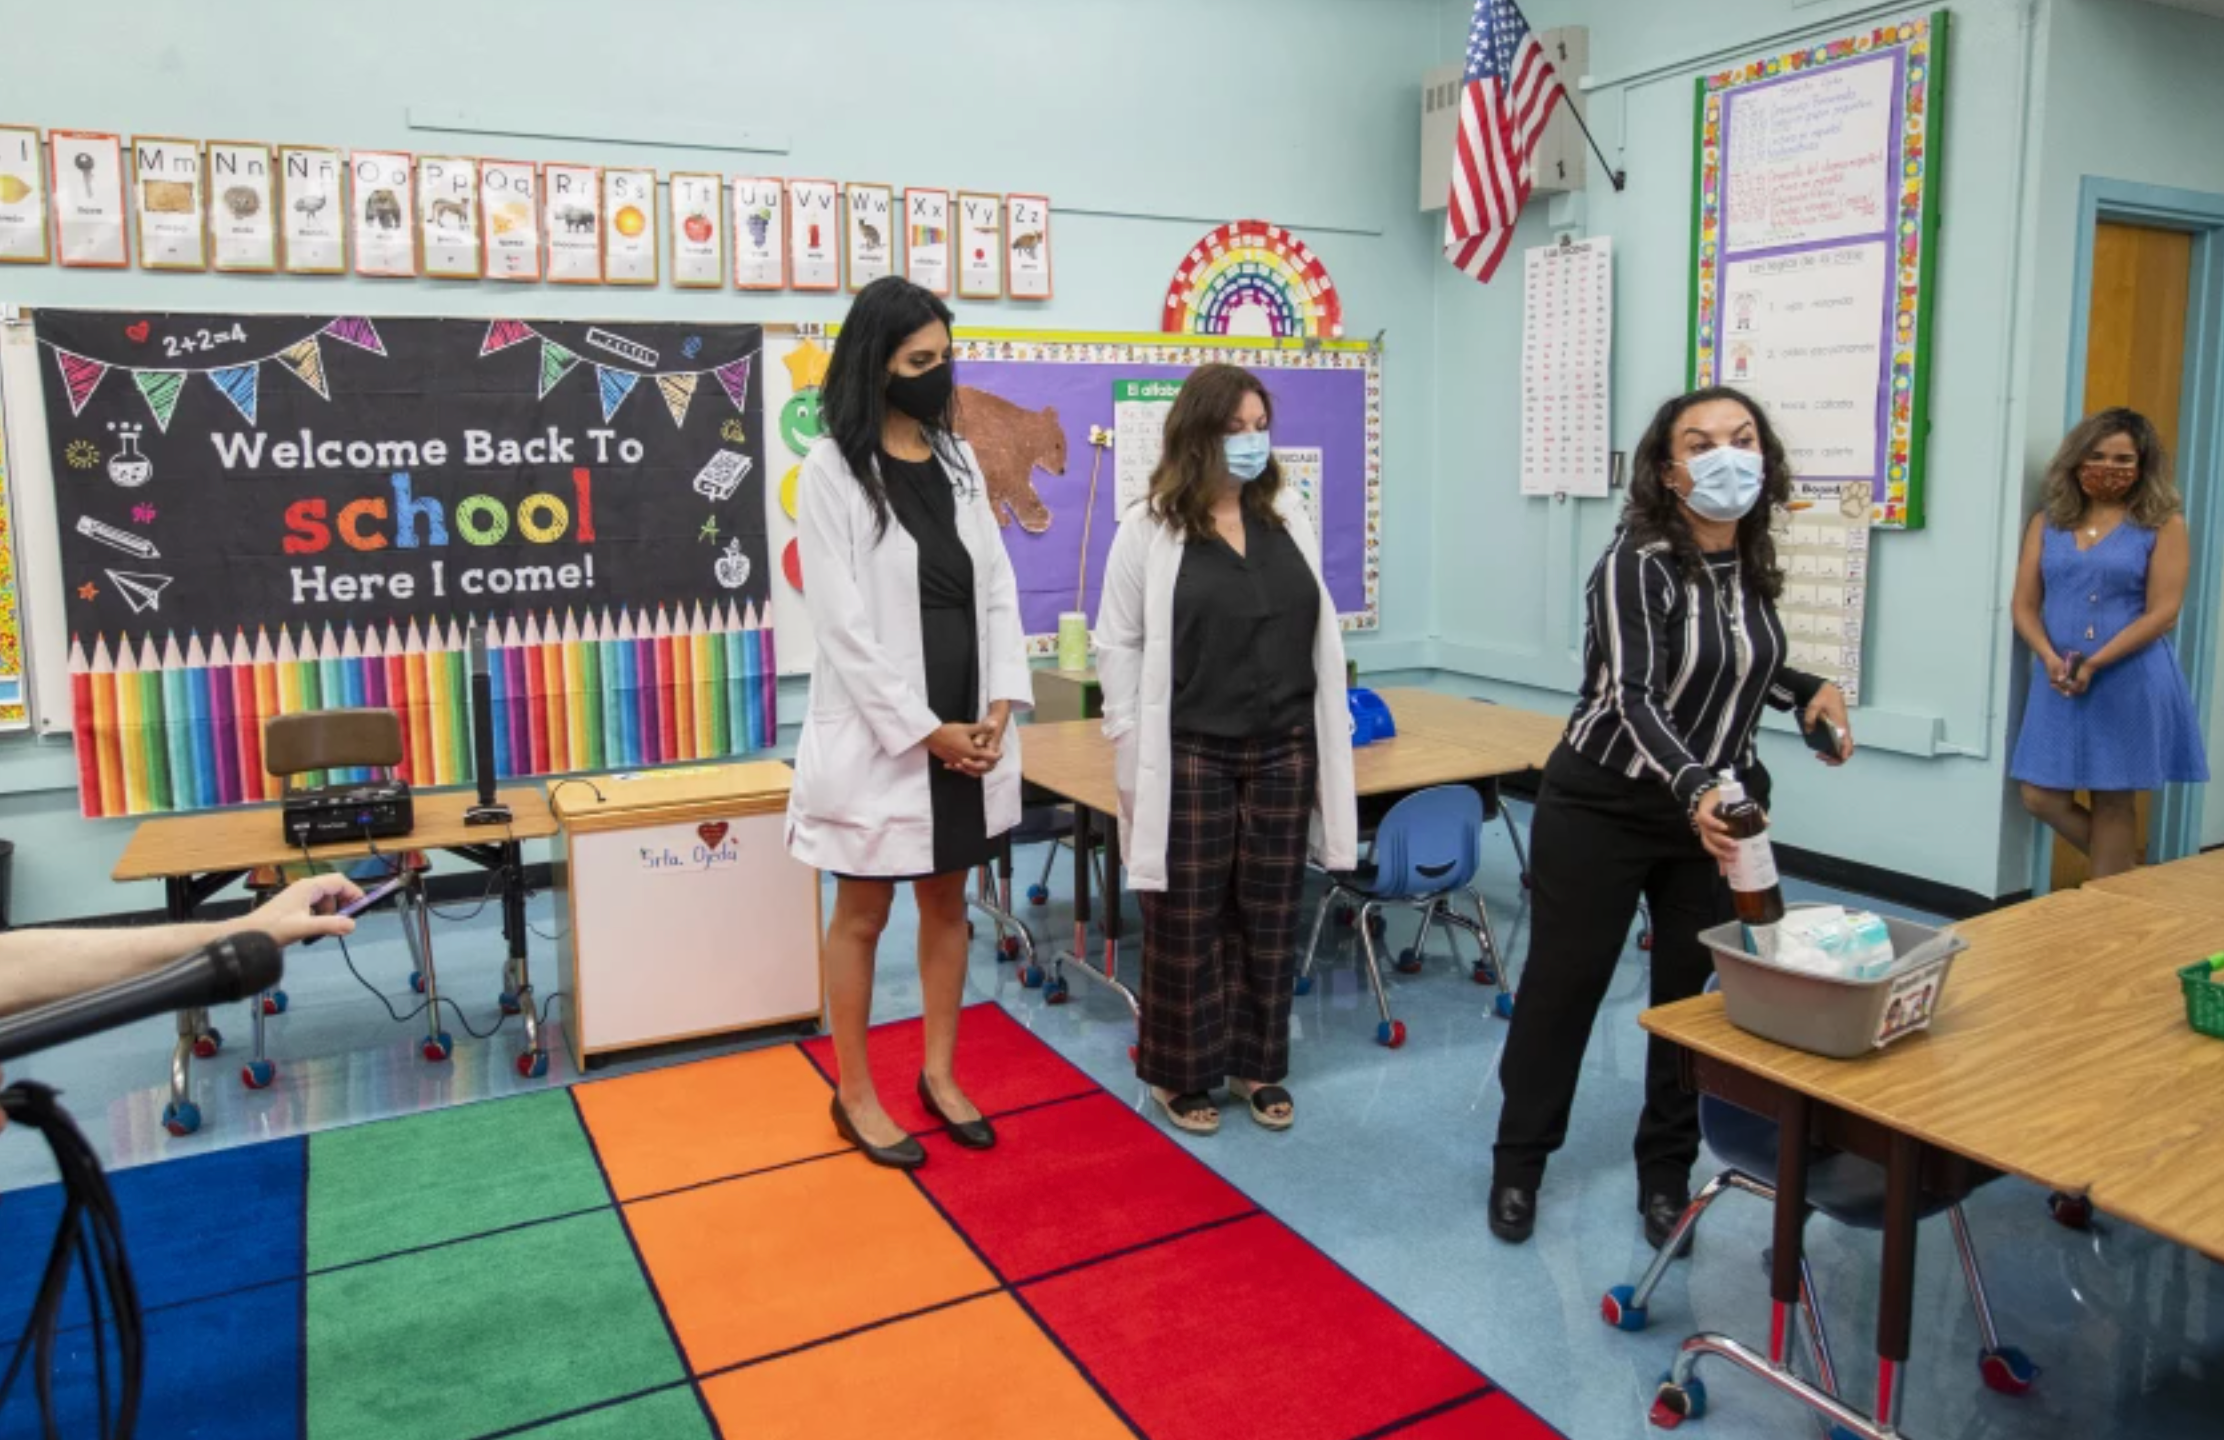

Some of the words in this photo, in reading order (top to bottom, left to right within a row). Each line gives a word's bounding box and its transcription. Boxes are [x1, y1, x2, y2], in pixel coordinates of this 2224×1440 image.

[162, 322, 248, 357] 2+2=4
[210, 428, 448, 469] Welcome
[463, 425, 575, 465] Back
[587, 429, 644, 464] To
[283, 467, 596, 554] school
[290, 564, 415, 604] Here
[431, 560, 446, 597] I
[460, 553, 595, 594] come!
[692, 843, 738, 870] Ojeda
